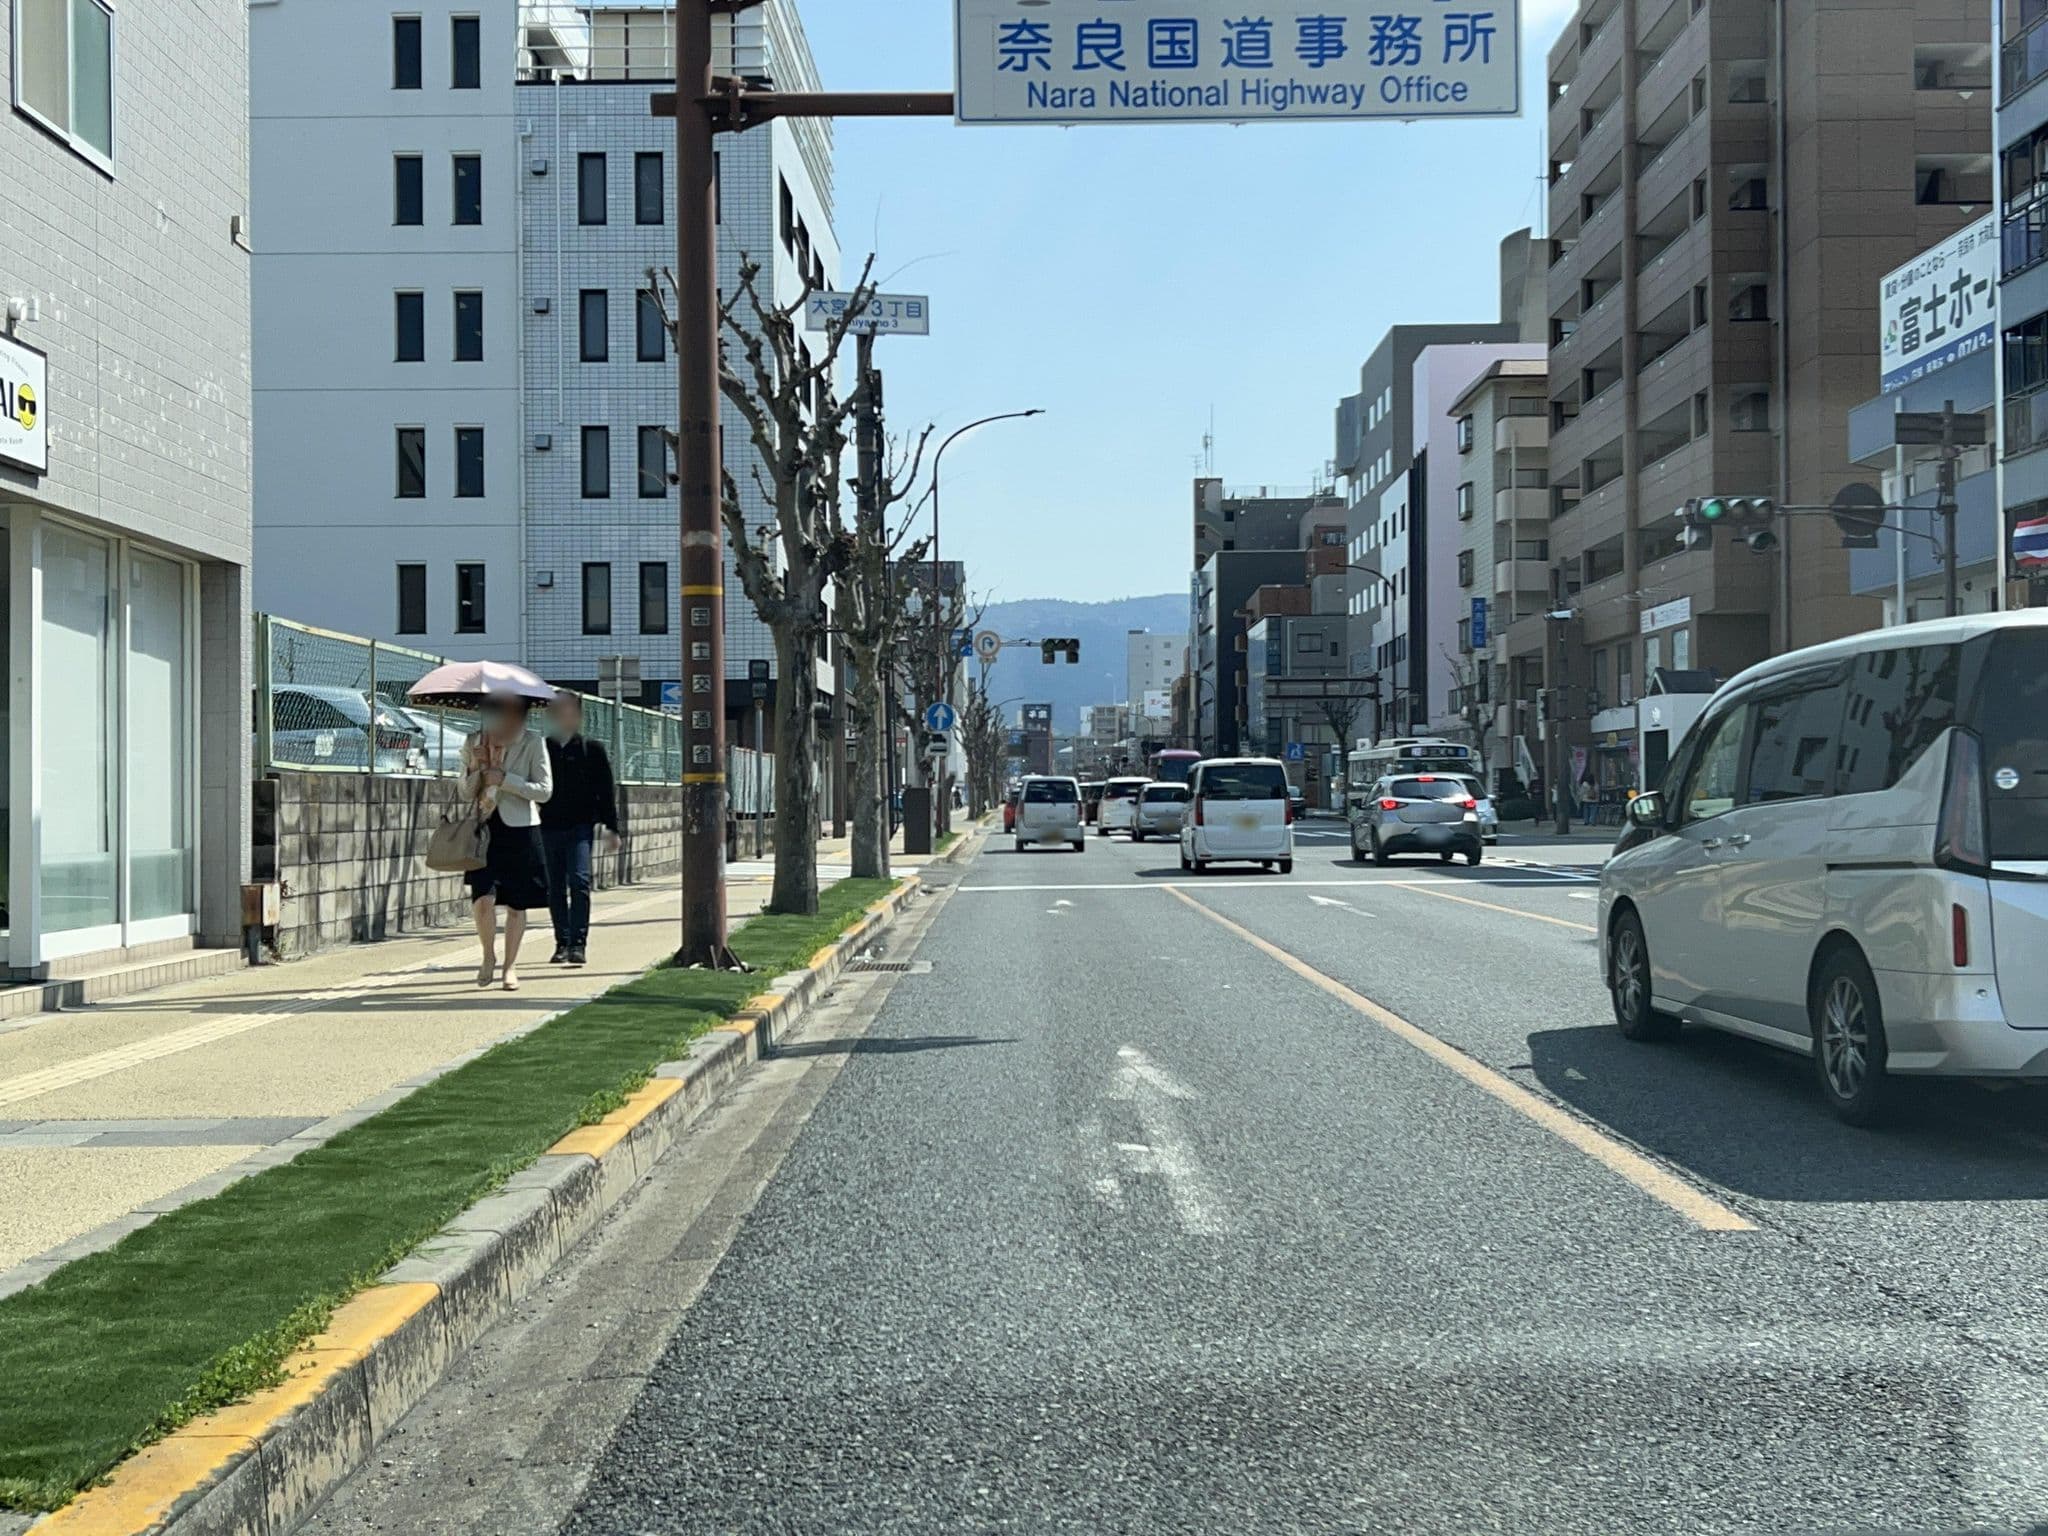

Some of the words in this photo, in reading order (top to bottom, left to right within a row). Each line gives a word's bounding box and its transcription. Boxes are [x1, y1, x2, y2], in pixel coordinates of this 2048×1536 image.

[998, 12, 1497, 72] 奈良国道事務所
[1028, 80, 1096, 108] Nara
[1109, 79, 1228, 108] National
[1241, 77, 1366, 111] Highway
[1380, 75, 1469, 104] Office
[812, 298, 922, 319] 大宮3丁目
